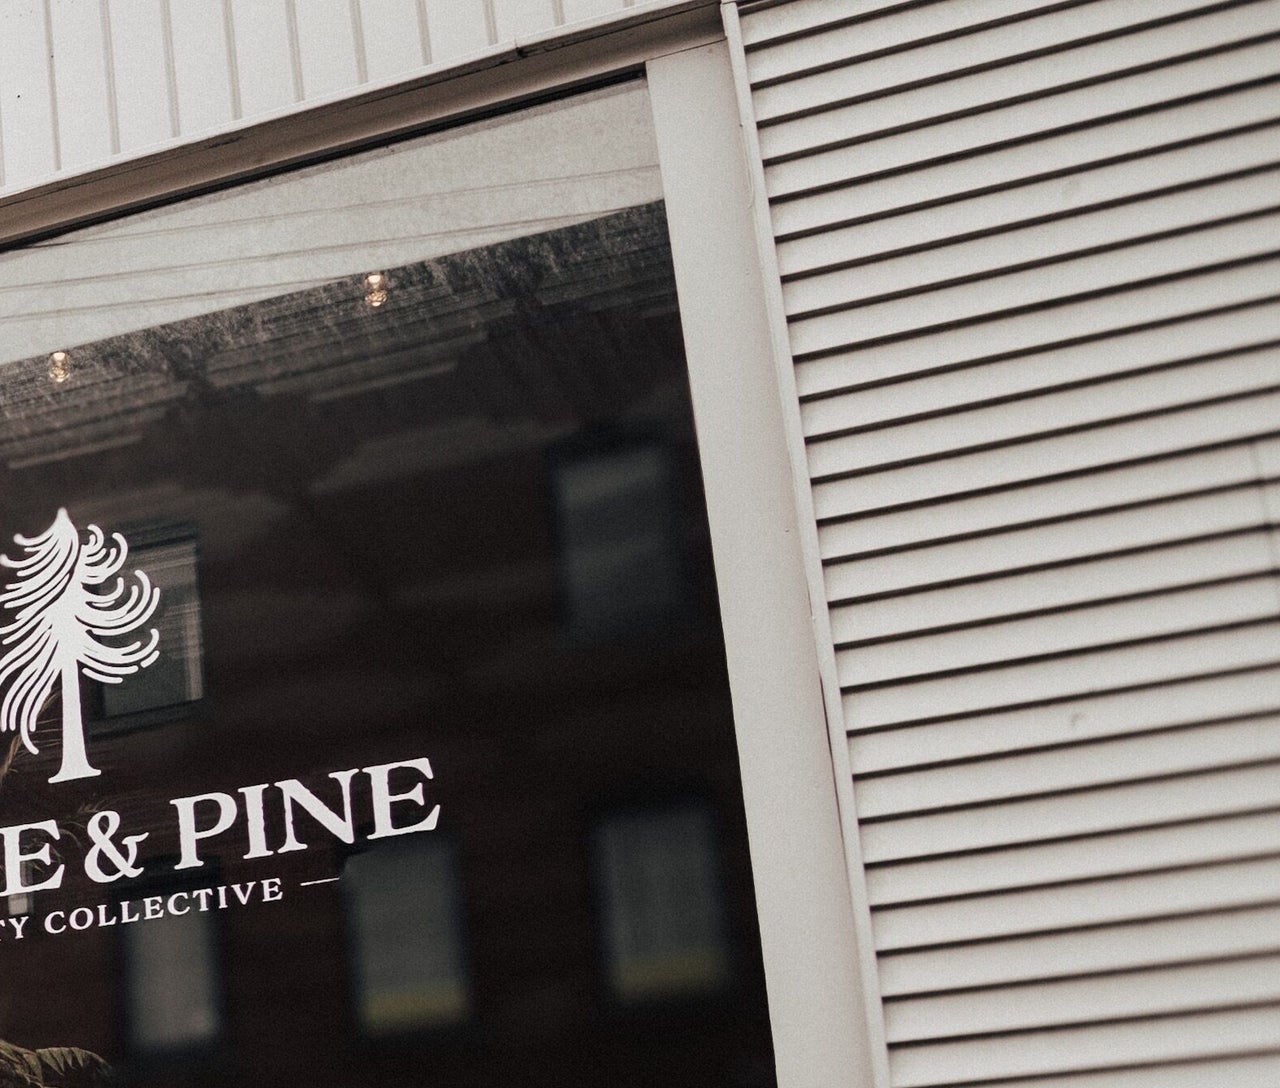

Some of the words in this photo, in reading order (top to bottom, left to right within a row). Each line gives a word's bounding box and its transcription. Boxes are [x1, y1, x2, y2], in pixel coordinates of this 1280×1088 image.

[84, 810, 149, 883] &
[169, 757, 441, 870] PINE
[44, 877, 284, 934] COLLECTIVE
